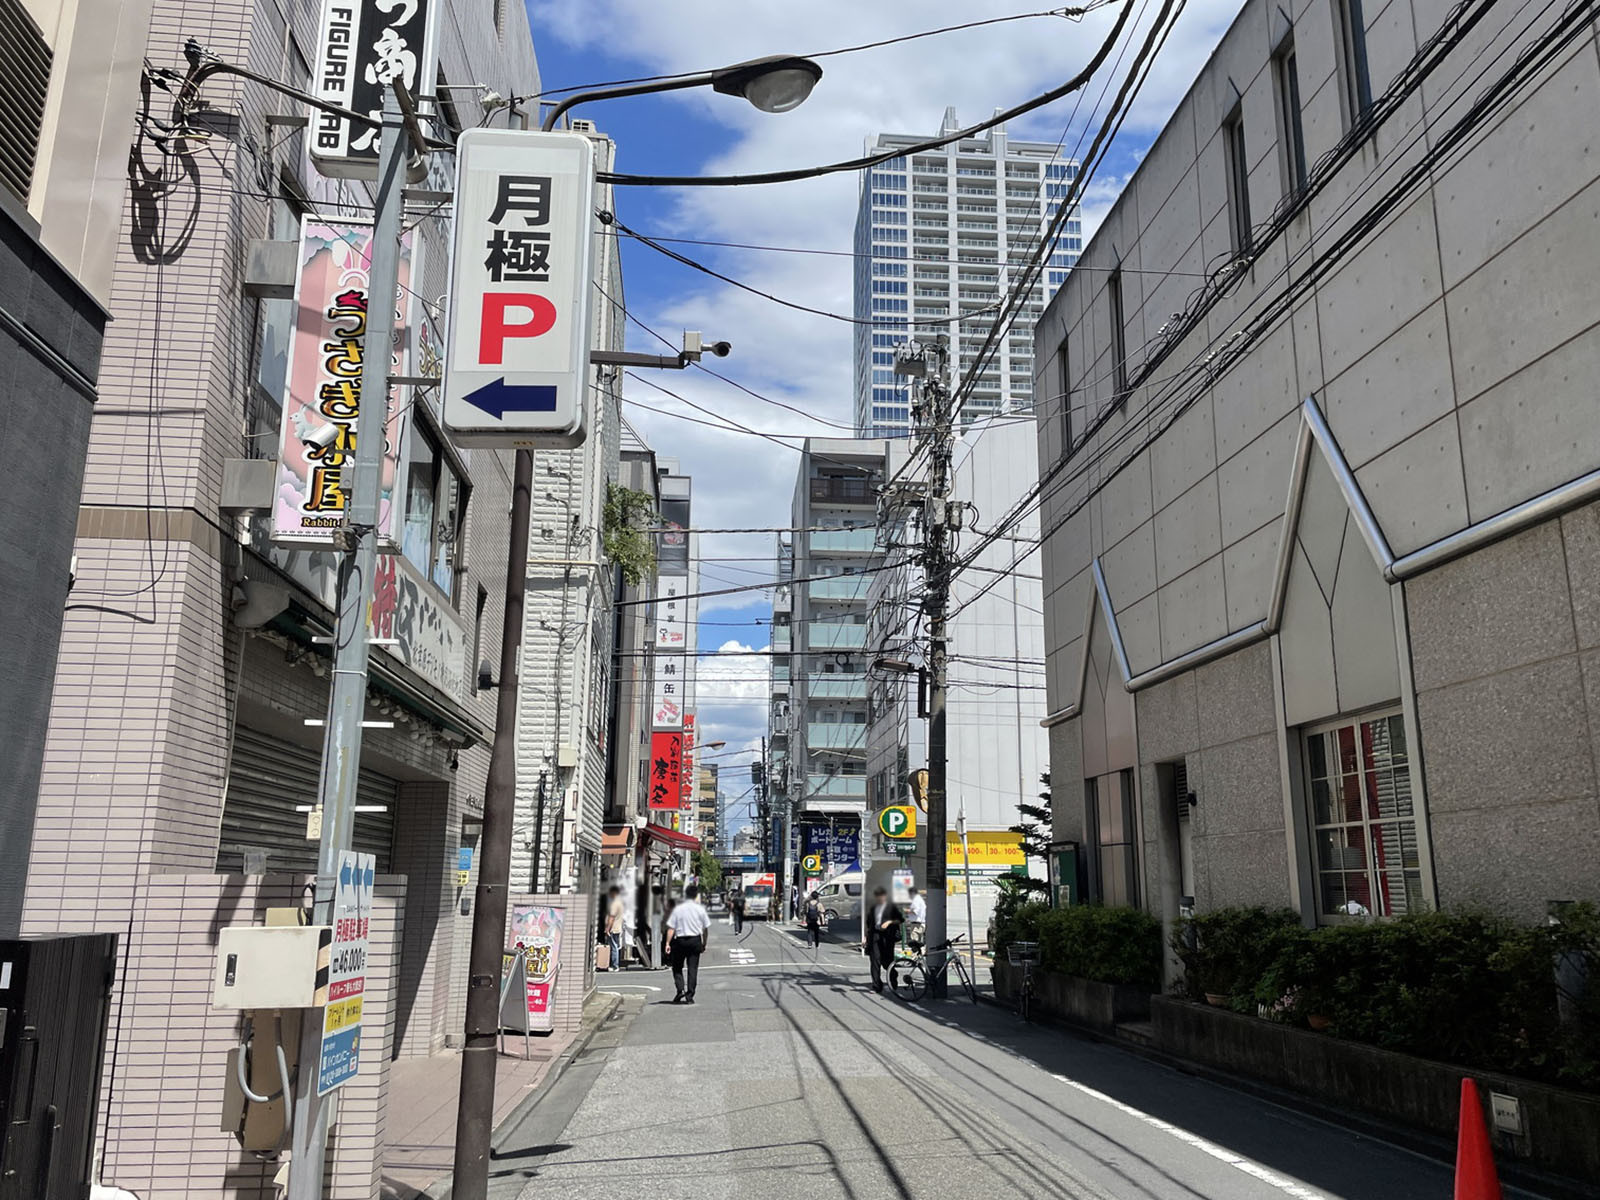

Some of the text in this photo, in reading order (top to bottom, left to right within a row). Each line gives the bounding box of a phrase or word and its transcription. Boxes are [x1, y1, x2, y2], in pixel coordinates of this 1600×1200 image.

[322, 8, 353, 92] FIGURE
[478, 174, 557, 365] 月極 P
[888, 812, 905, 833] P
[807, 858, 815, 868] P
[334, 917, 369, 943] 月極駐車場
